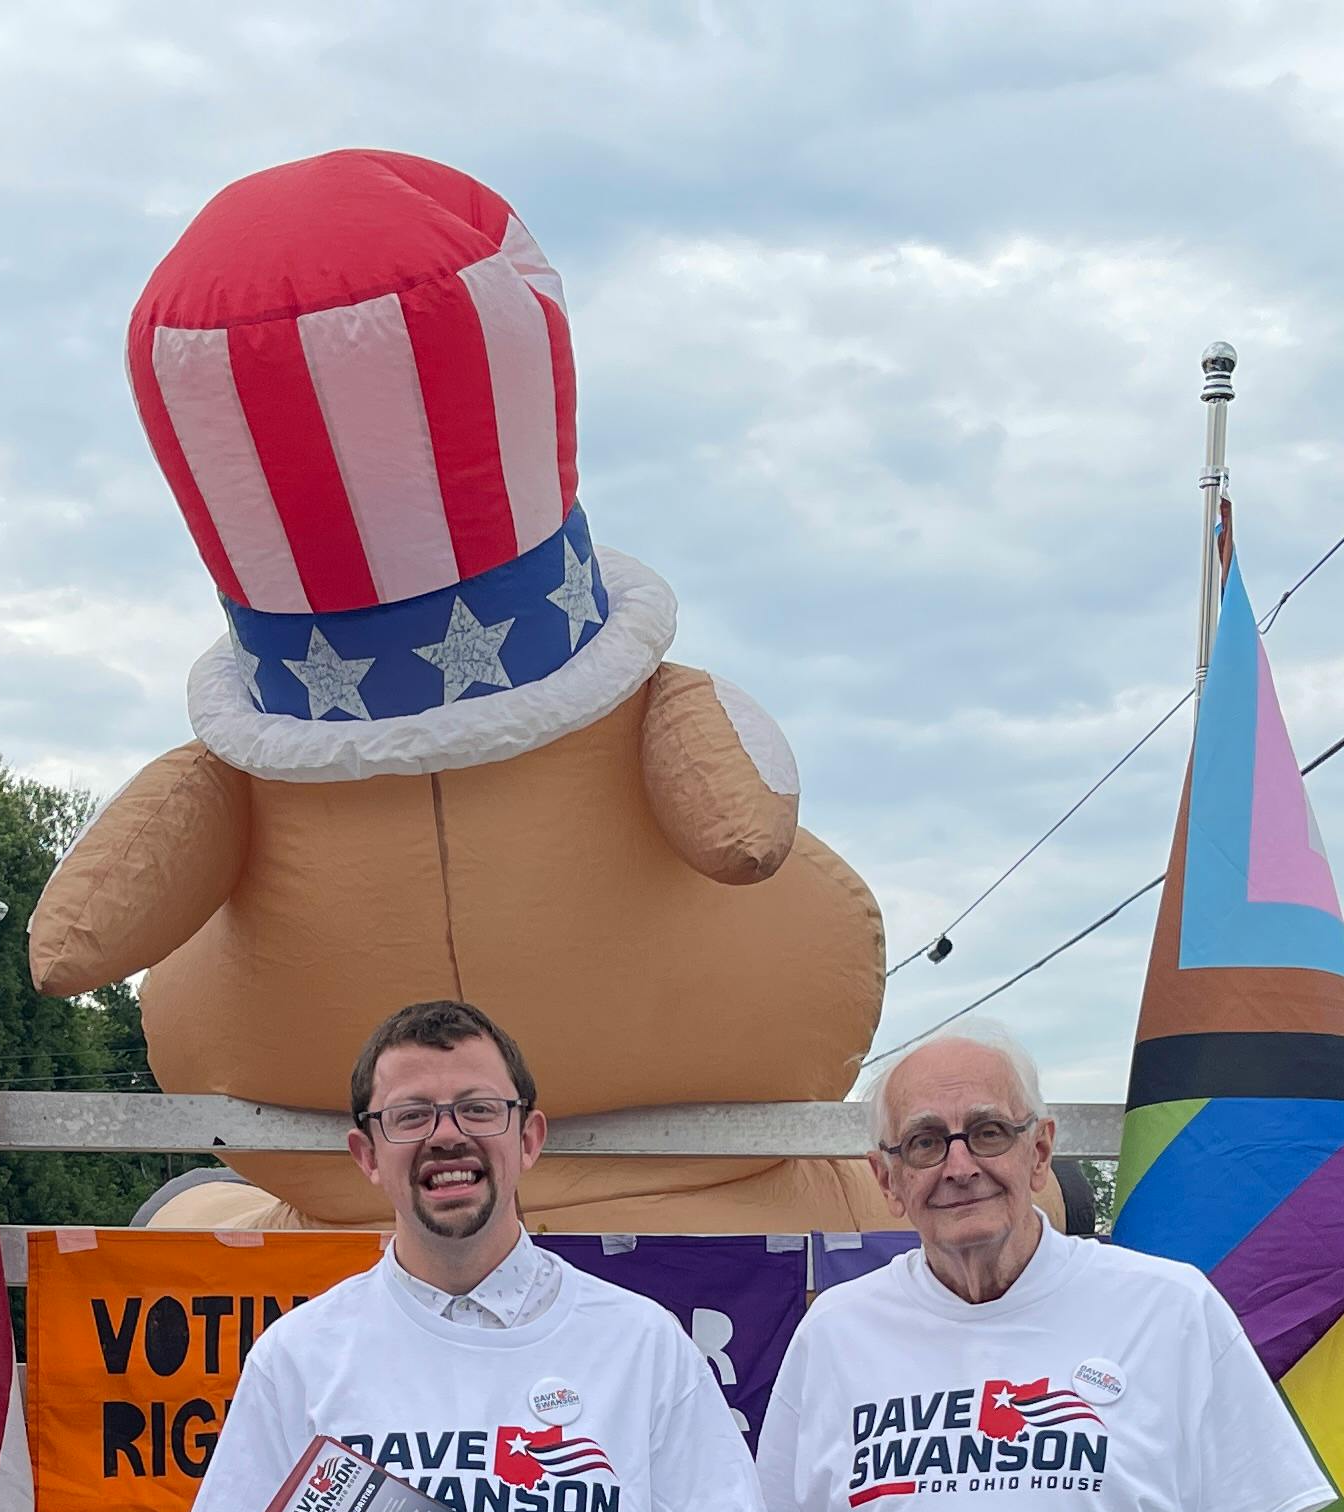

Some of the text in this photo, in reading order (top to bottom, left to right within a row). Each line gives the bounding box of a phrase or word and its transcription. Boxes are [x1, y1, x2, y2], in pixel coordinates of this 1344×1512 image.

[103, 1398, 233, 1478] RIG
[853, 1388, 975, 1446] DAVE
[848, 1430, 1108, 1489] SWANSON
[918, 1477, 1102, 1493] FOR OHIO HOUSE
